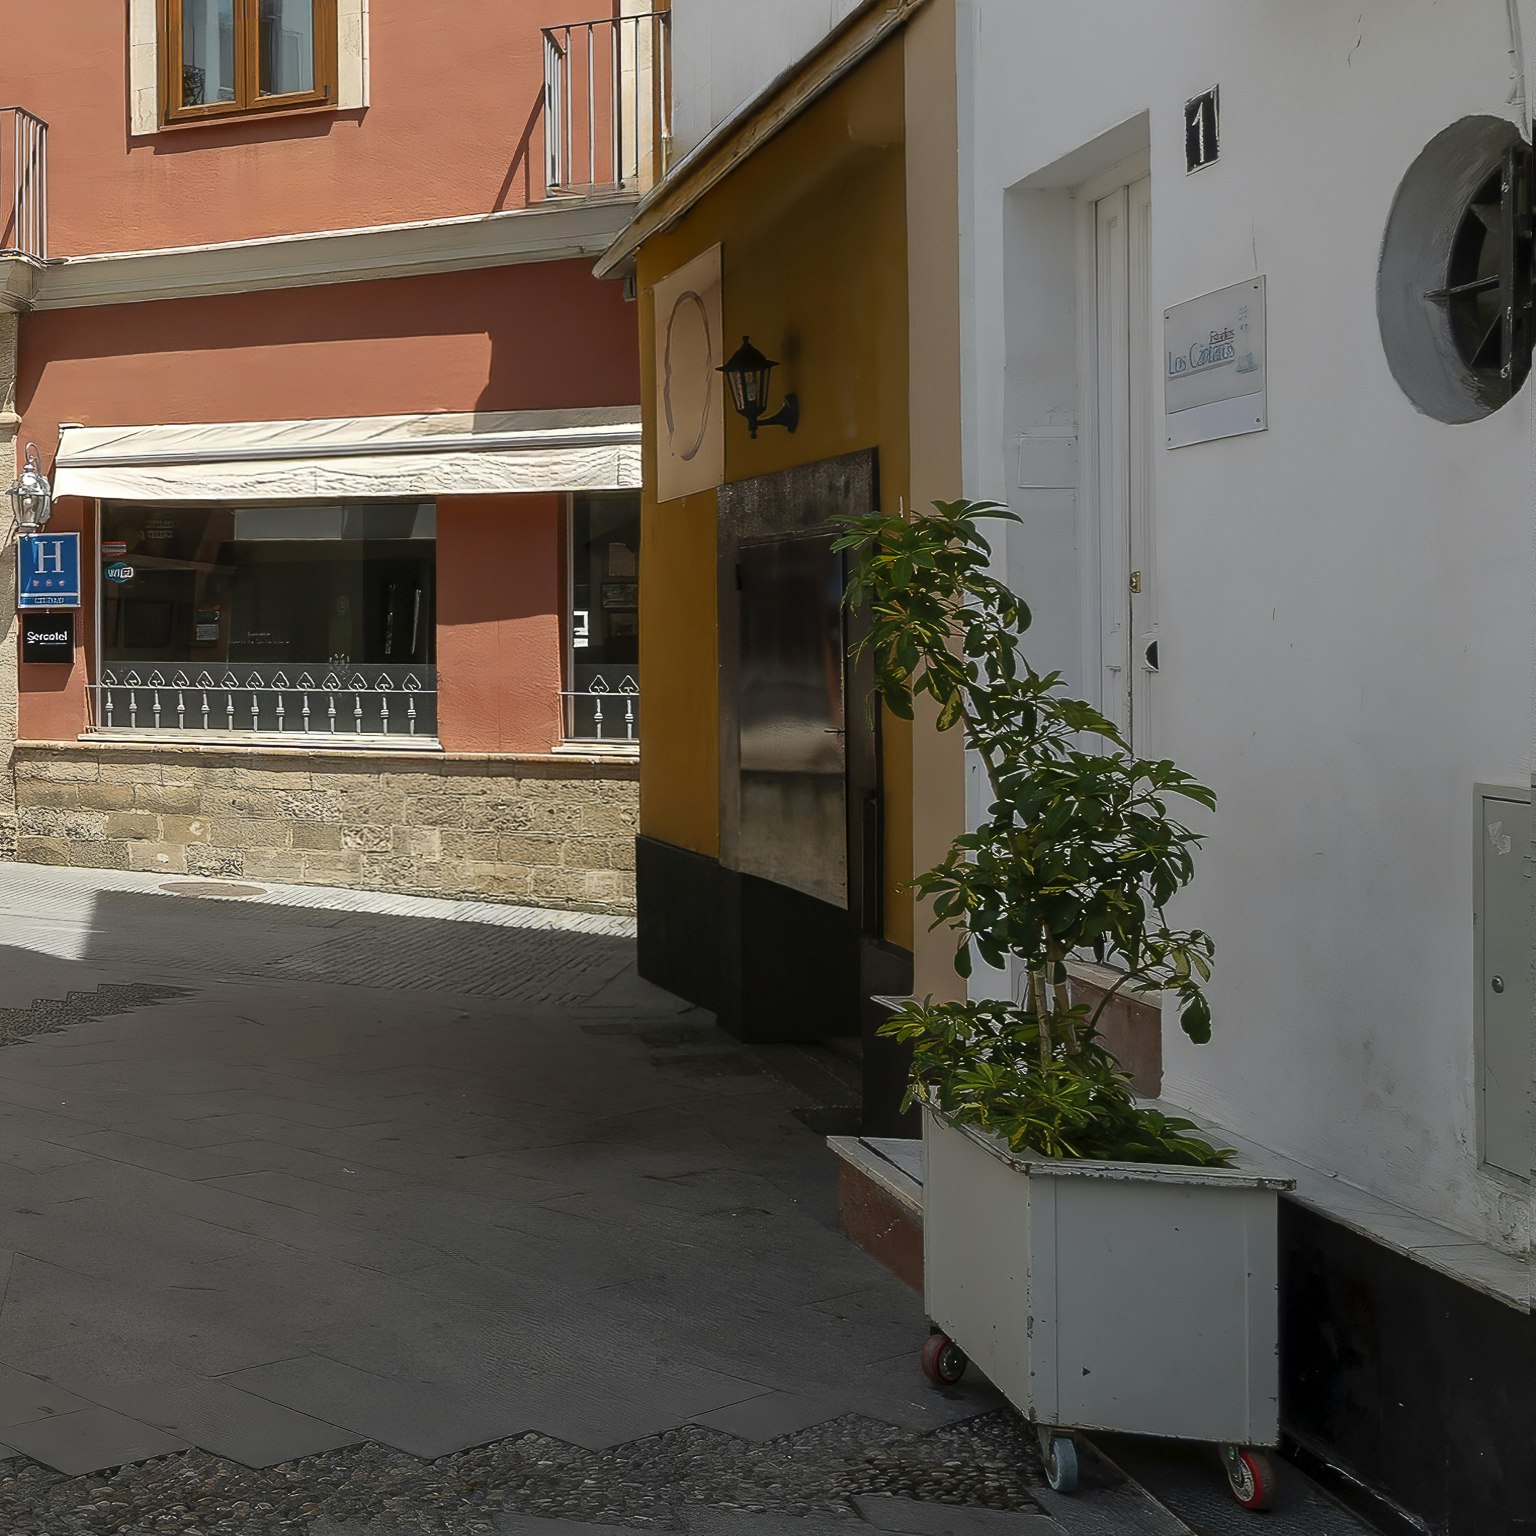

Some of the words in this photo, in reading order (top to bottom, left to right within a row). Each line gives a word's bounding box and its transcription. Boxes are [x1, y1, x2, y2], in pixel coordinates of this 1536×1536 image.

[1191, 102, 1205, 163] 1
[34, 540, 65, 574] H
[26, 630, 68, 642] Sercotel
